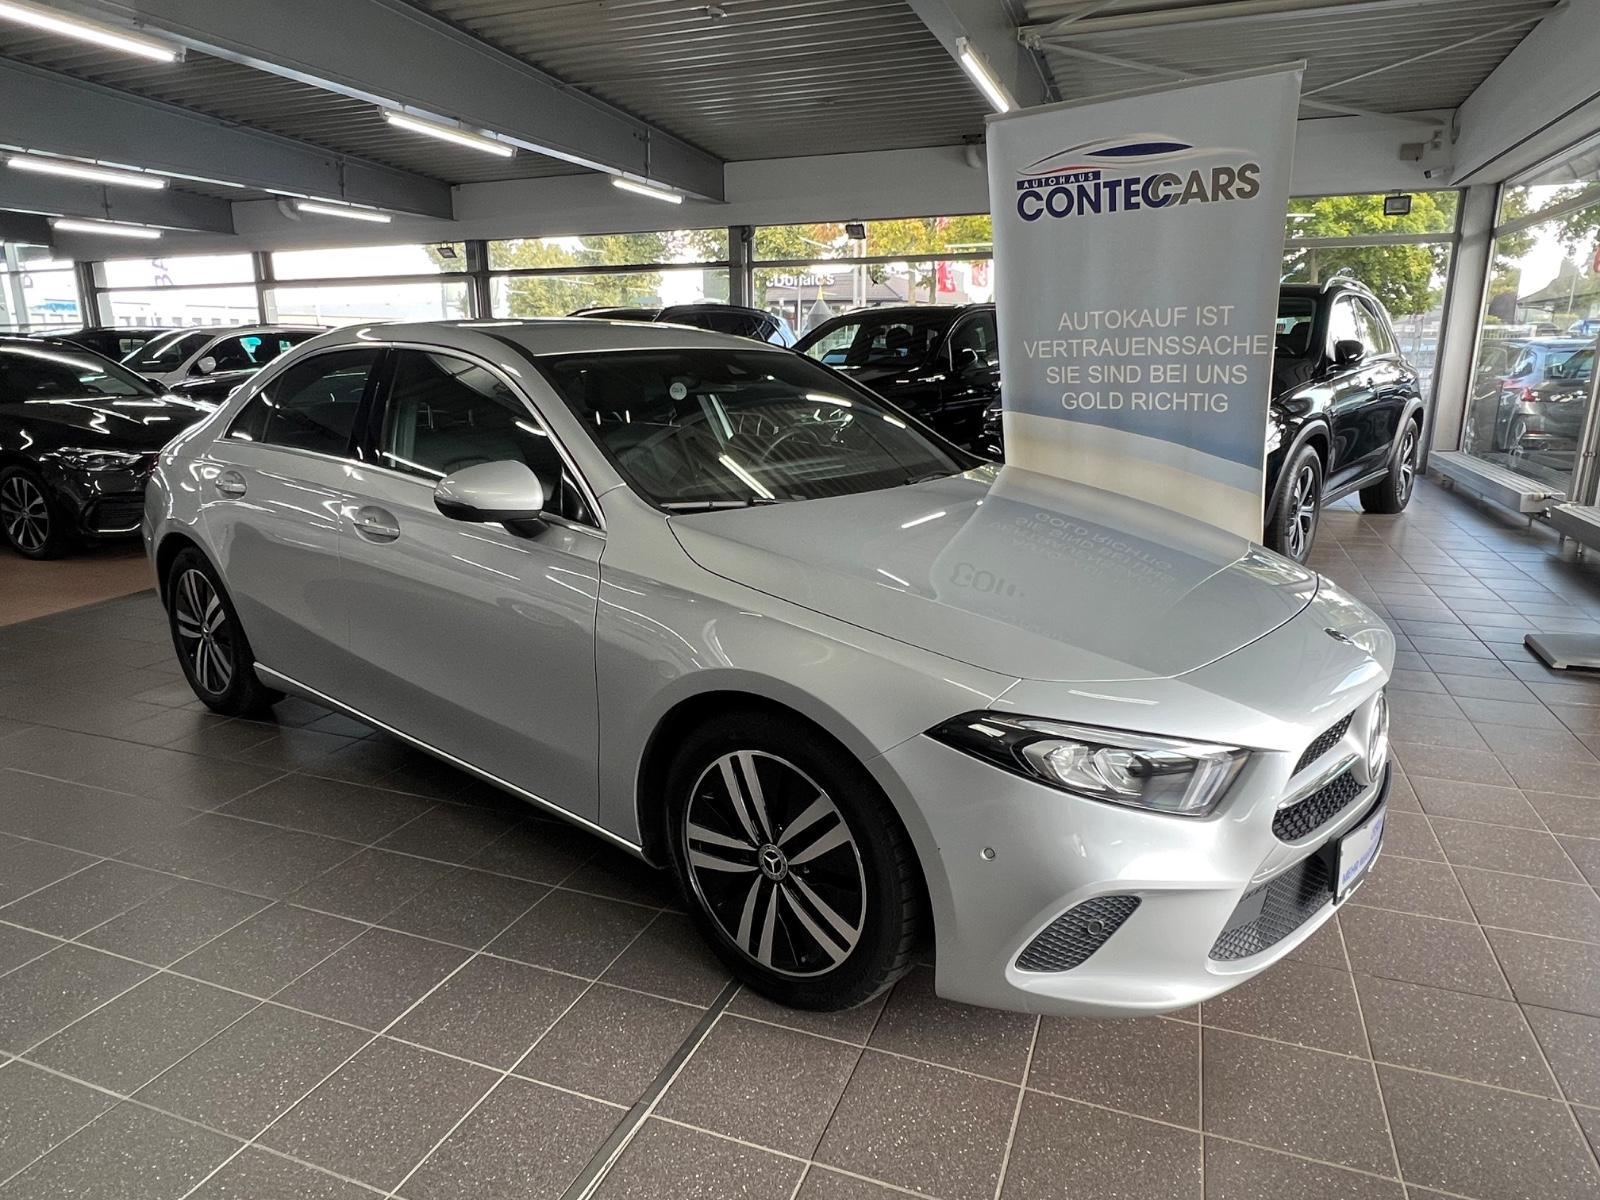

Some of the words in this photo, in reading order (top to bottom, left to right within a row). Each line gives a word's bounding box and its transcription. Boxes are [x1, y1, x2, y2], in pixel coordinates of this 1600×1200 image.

[1023, 172, 1094, 189] AUTOHAUS
[1058, 307, 1187, 331] AUTOKAUF
[1195, 306, 1234, 327] IST
[1024, 335, 1268, 358] VERTRAUENSSACHE
[1046, 366, 1081, 384] SIE
[1088, 365, 1141, 384] SIND
[1150, 364, 1187, 384] BEI
[1196, 364, 1248, 385] UNS
[1061, 391, 1124, 410] GOLD
[1131, 392, 1229, 413] RICHTIG
